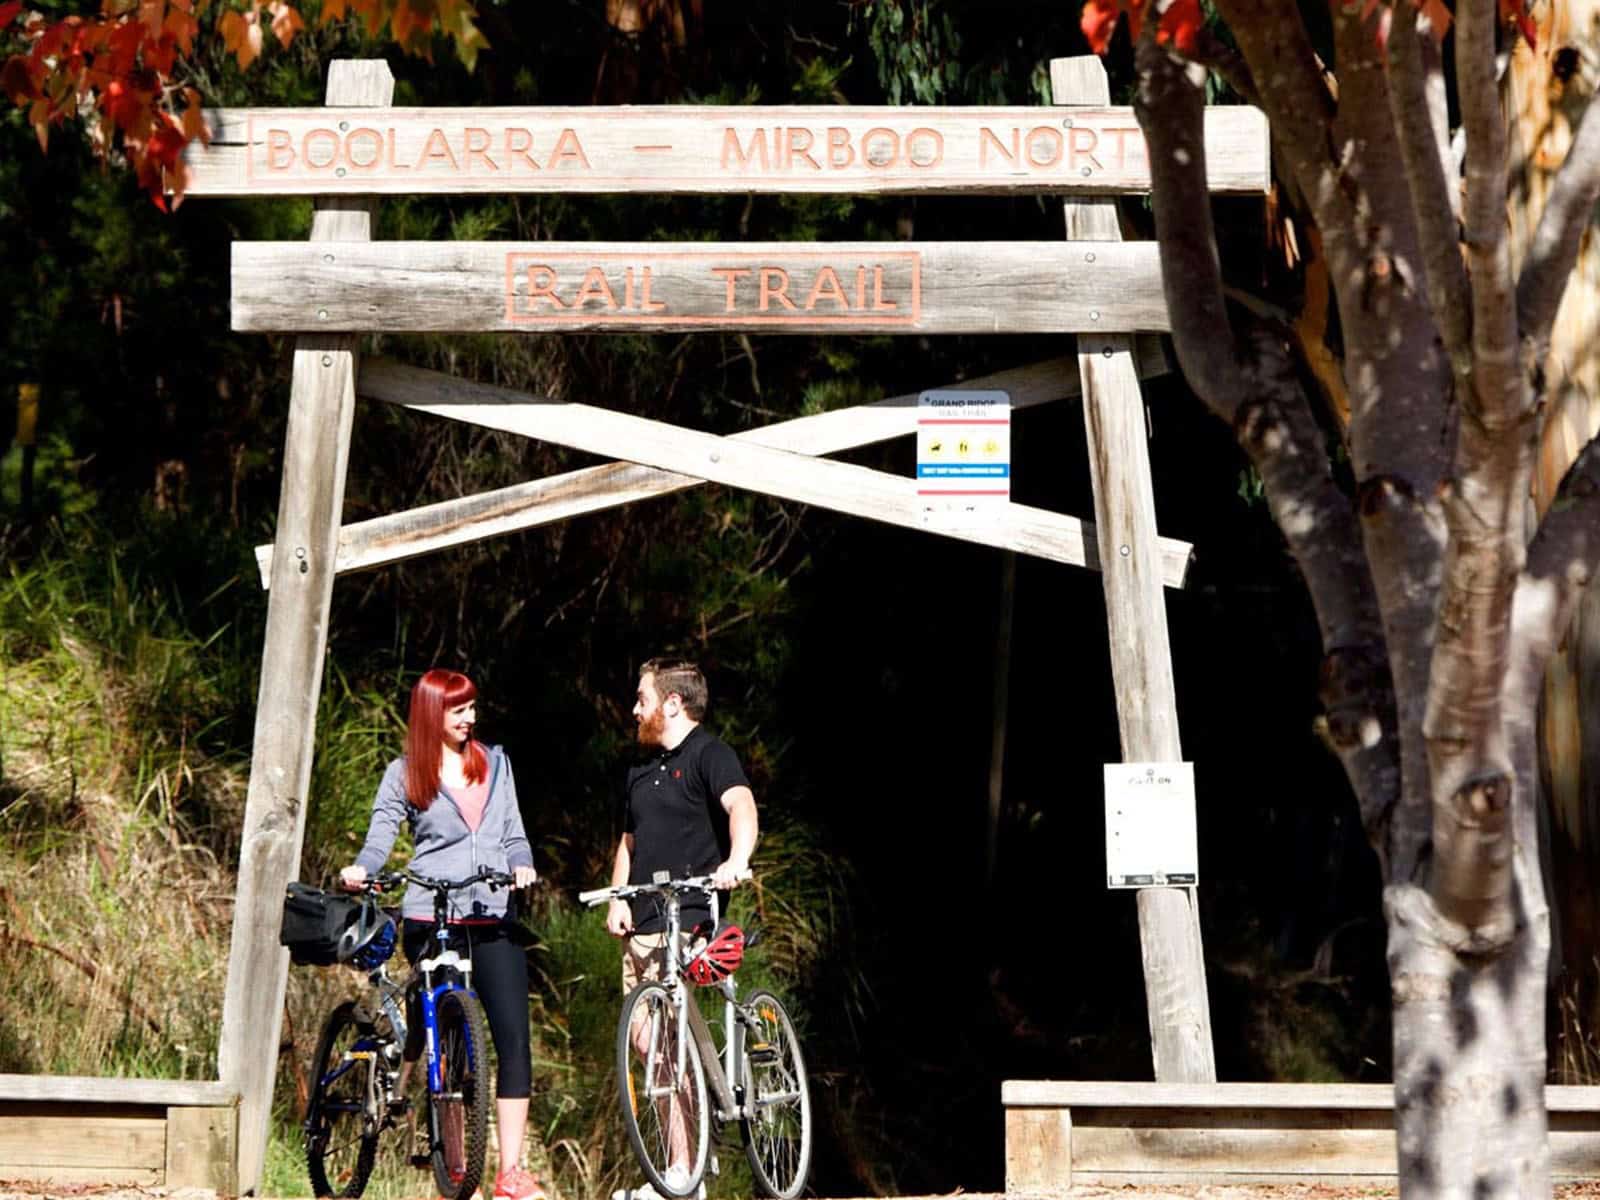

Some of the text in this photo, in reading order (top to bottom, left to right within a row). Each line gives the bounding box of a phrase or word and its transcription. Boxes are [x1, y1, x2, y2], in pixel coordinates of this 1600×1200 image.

[267, 127, 592, 171] BOOLARRA
[719, 126, 944, 171] MIRBOO
[979, 126, 1152, 171] NORT
[526, 265, 898, 312] RAIL TRAIL
